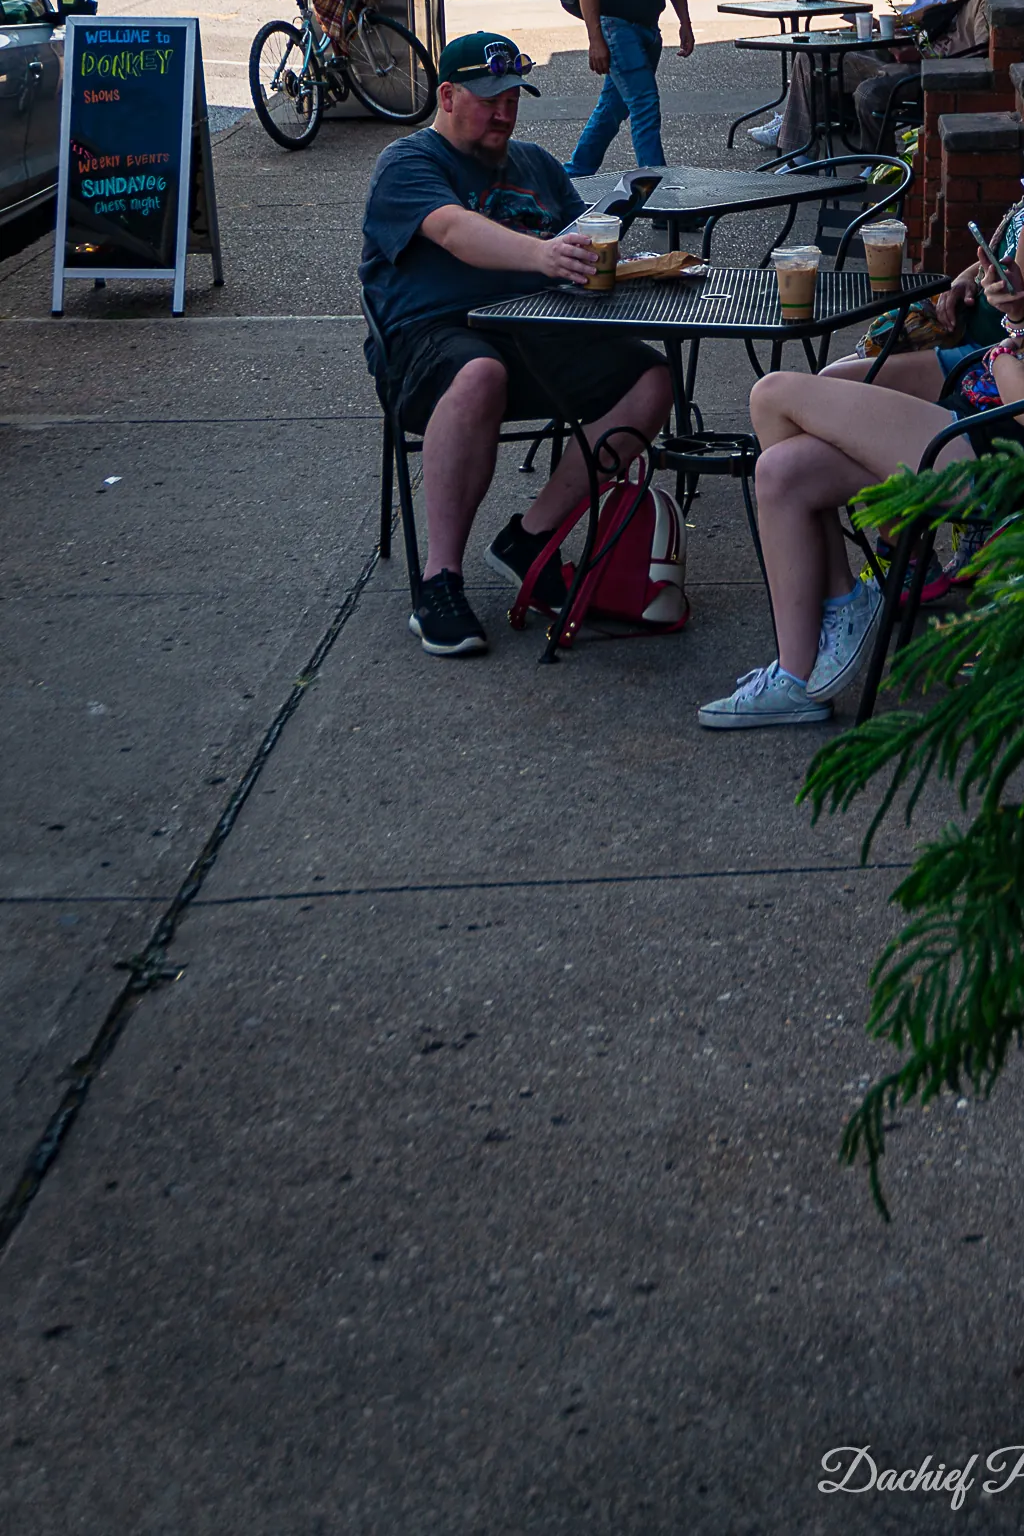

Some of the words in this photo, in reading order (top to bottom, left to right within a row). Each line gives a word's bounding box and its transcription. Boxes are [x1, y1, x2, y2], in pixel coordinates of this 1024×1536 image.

[155, 31, 170, 44] to
[81, 49, 174, 80] DONKEY
[126, 153, 170, 167] EVENTS
[130, 196, 160, 216] night
